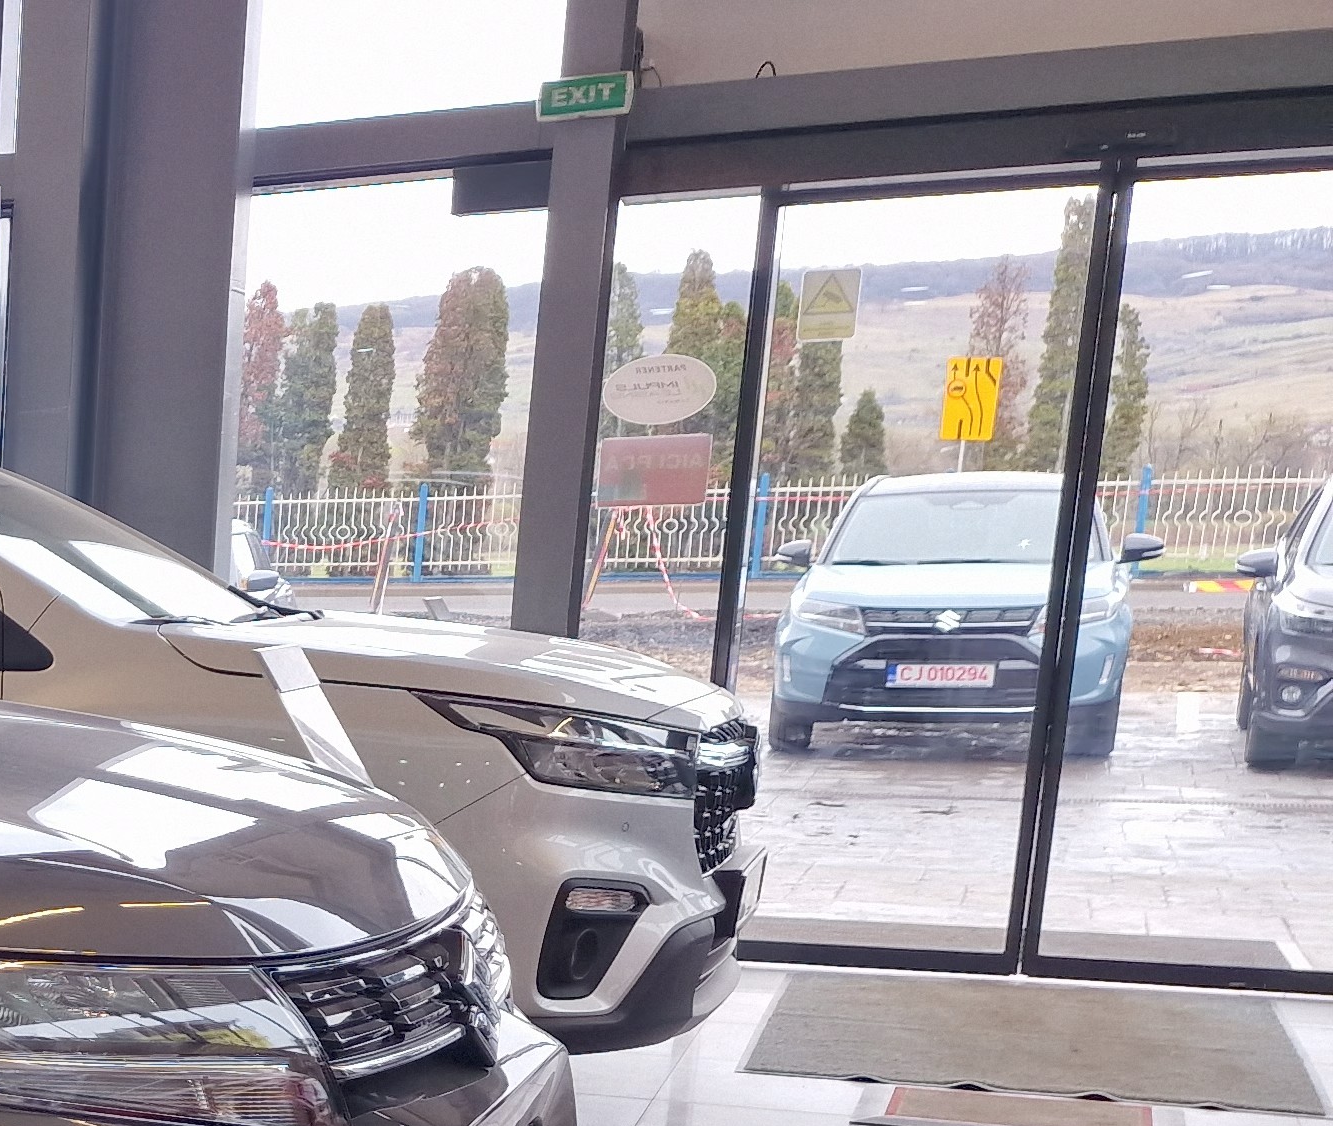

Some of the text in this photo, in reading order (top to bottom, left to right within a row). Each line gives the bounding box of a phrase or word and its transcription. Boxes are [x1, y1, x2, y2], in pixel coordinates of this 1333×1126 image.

[551, 82, 616, 108] EXIT
[900, 666, 923, 681] CJ
[926, 665, 988, 681] 010294
